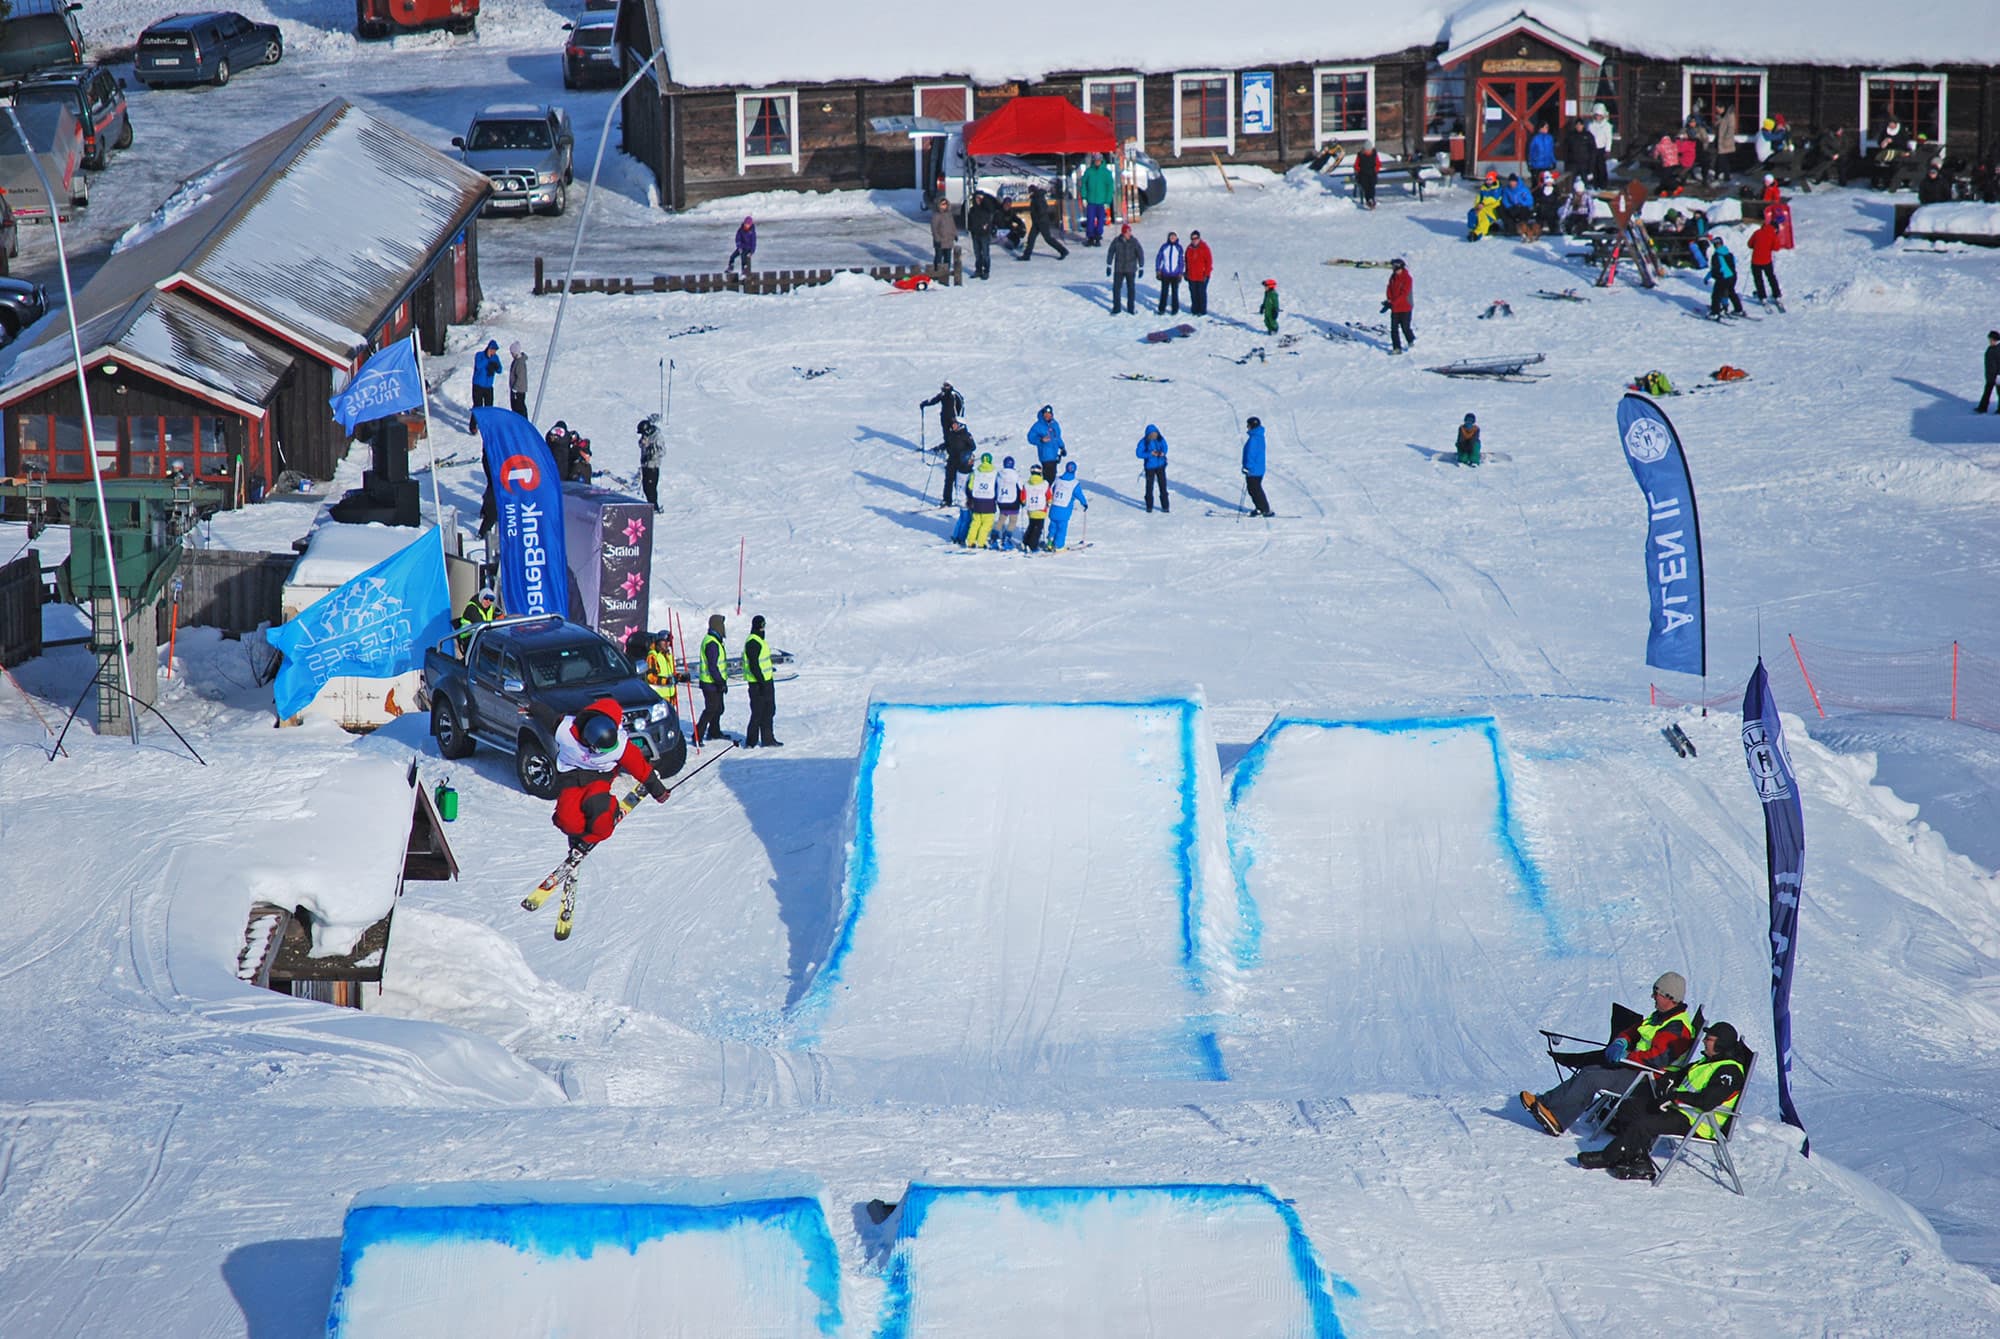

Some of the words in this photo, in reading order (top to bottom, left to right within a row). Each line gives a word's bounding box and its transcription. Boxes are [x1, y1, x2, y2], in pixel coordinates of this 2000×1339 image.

[1030, 496, 1039, 504] 52
[606, 546, 639, 557] Statoil
[606, 599, 638, 611] Statoil
